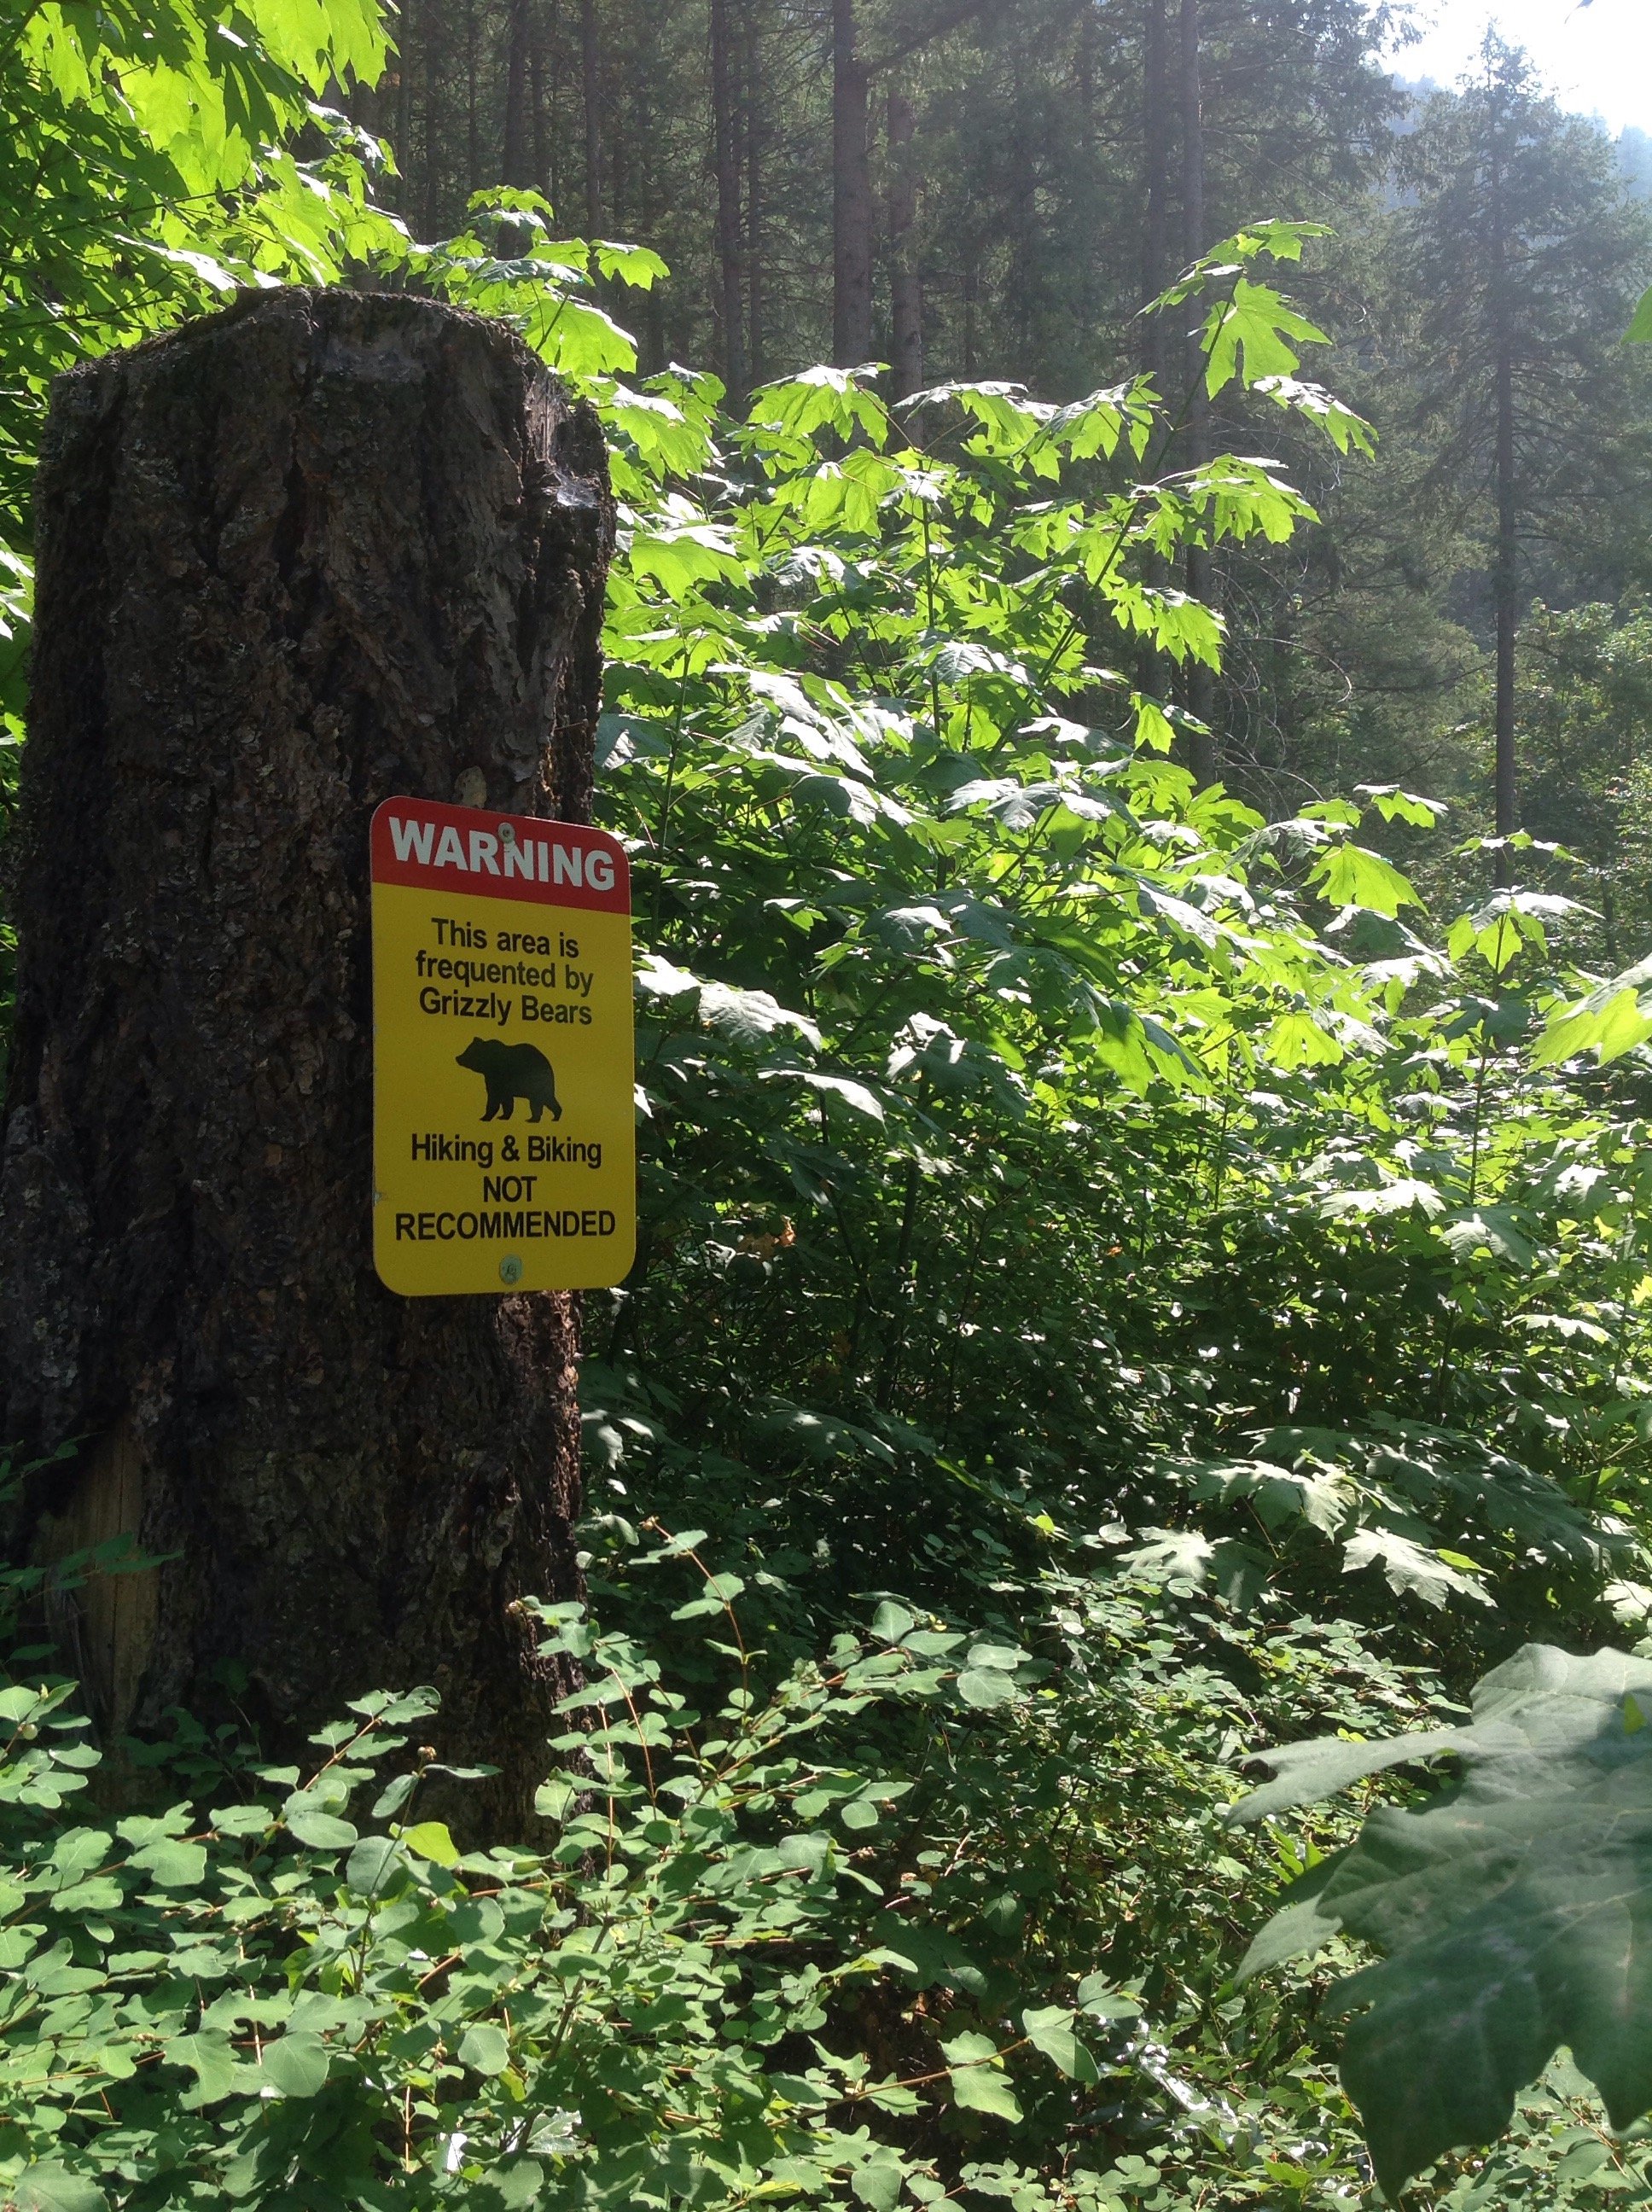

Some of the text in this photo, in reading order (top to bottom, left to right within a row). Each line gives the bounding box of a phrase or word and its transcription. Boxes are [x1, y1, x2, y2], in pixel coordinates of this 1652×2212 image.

[388, 817, 614, 891] WARNING
[431, 917, 579, 958] This area is
[416, 950, 594, 998] frequented by
[419, 987, 592, 1026] Grizzly Bears
[411, 1133, 602, 1169] Hiking & Biking
[483, 1176, 538, 1202] NOT
[395, 1210, 616, 1241] RECOMMENDED
